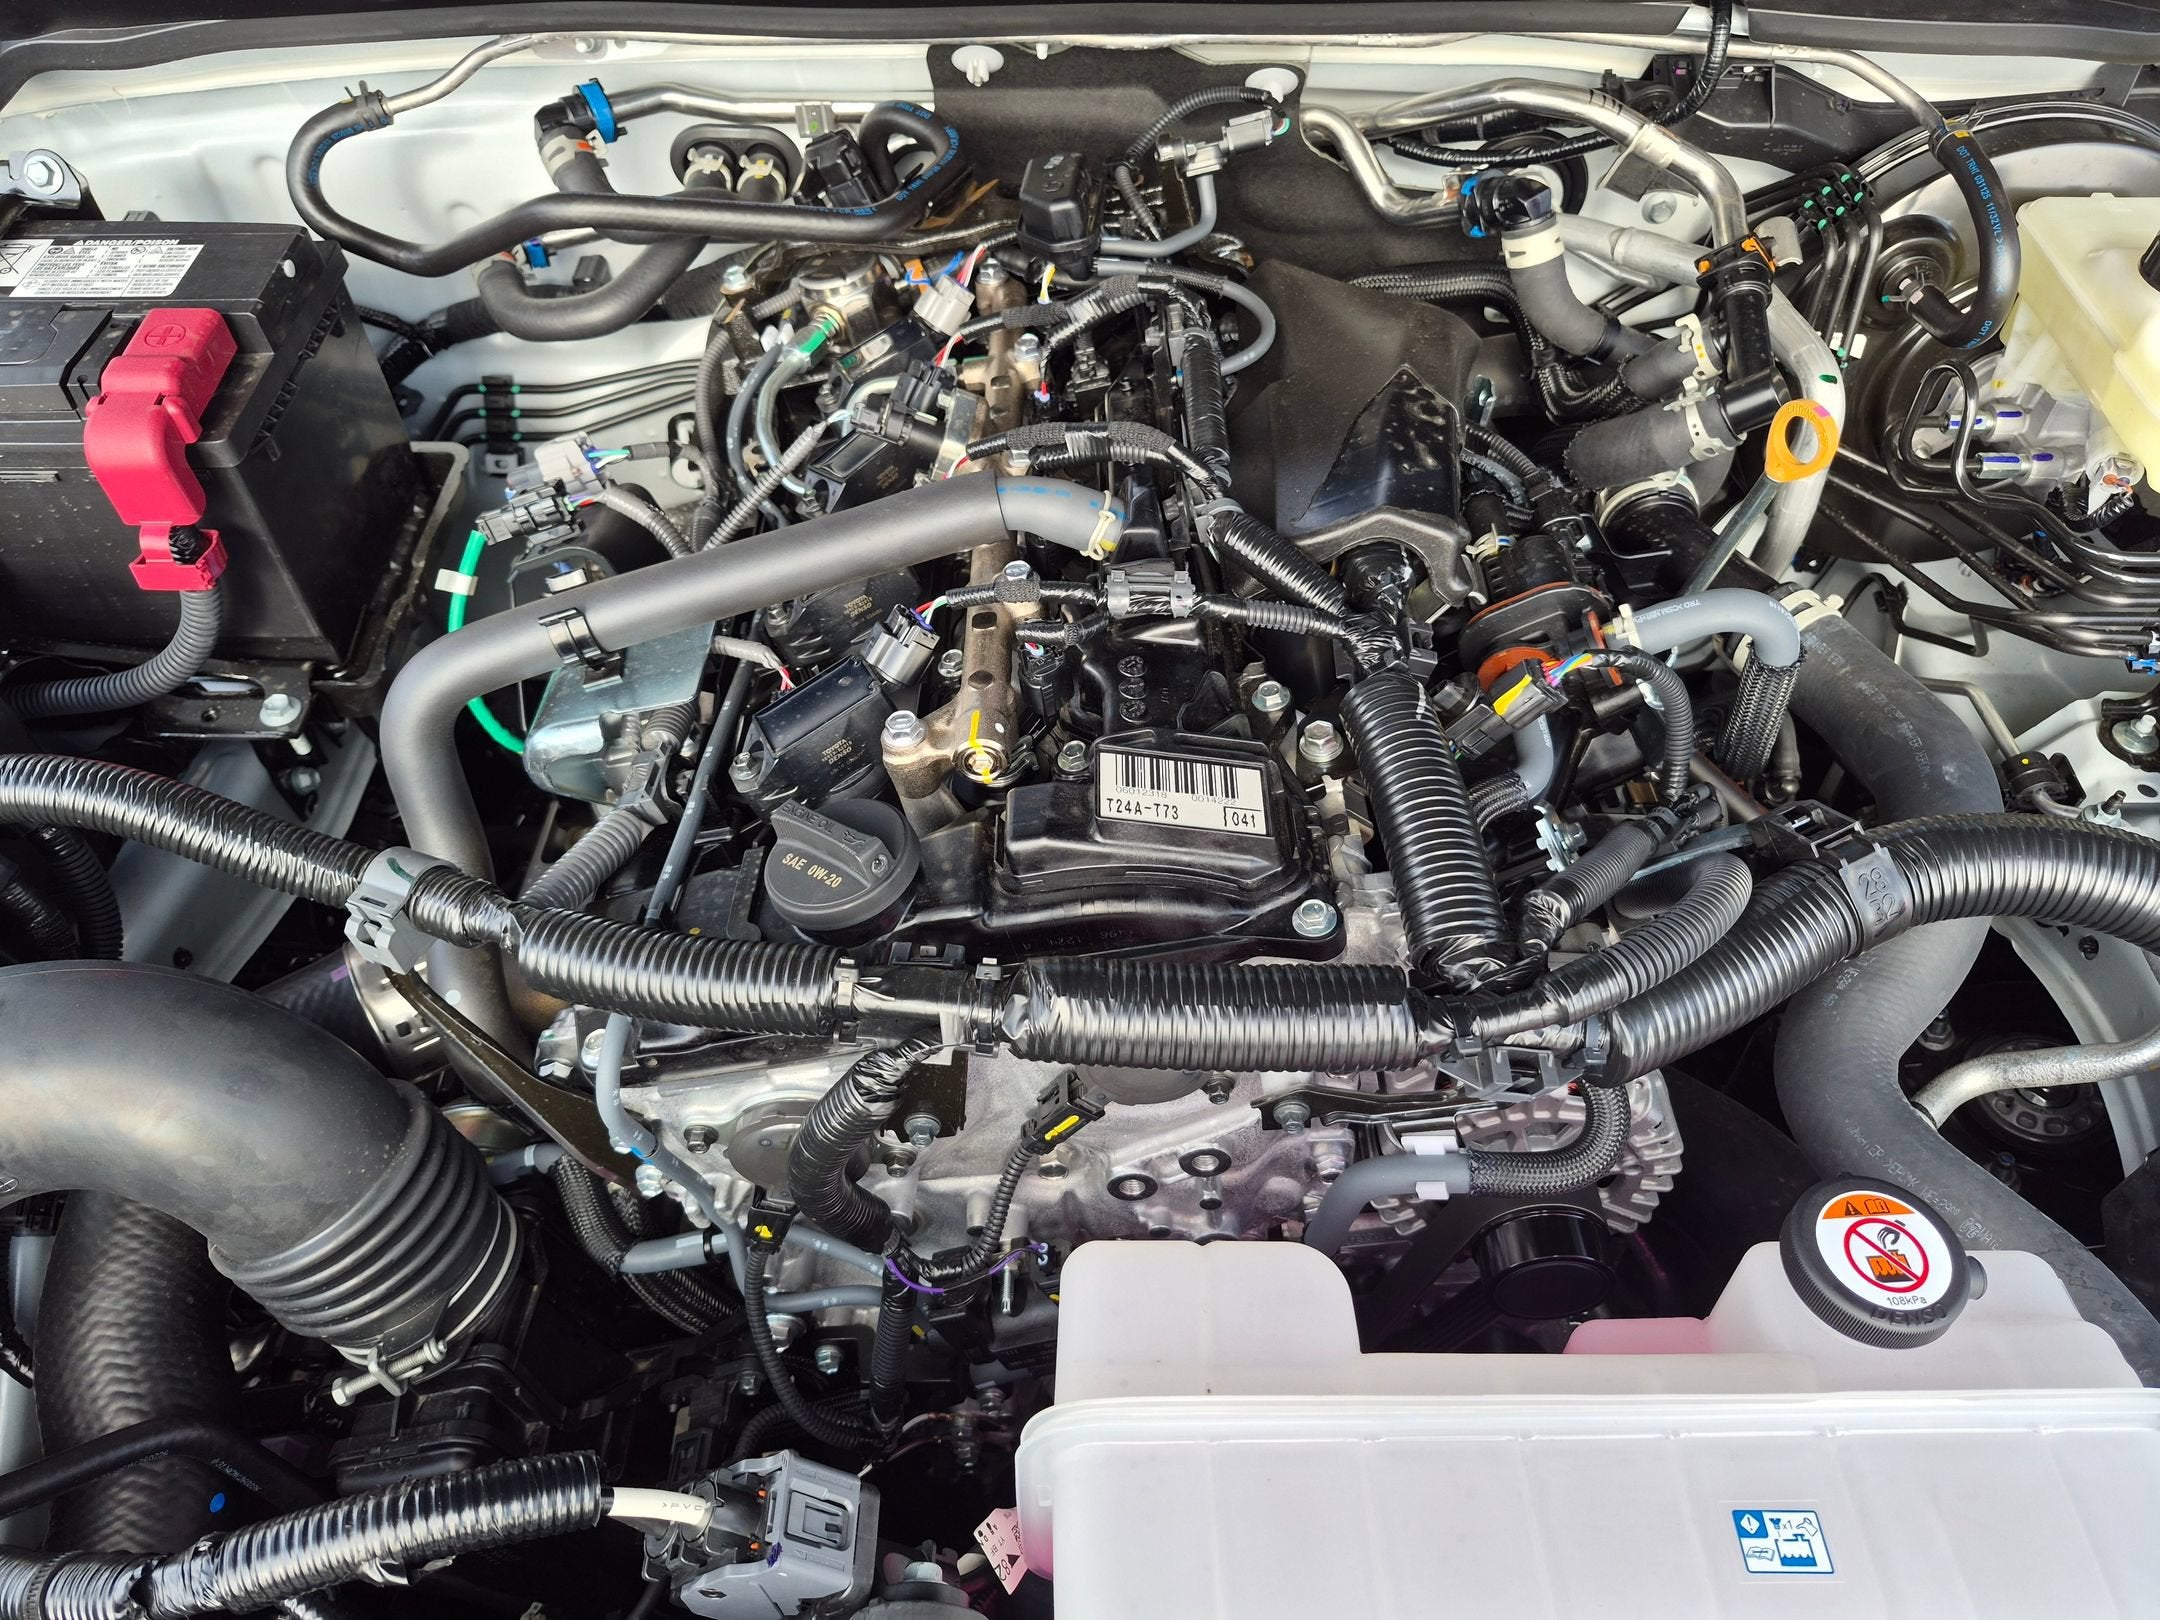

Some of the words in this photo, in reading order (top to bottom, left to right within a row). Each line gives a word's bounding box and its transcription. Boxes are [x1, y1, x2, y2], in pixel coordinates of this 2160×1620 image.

[1955, 145, 1970, 161] DOT
[1973, 172, 1993, 201] 031125
[1978, 320, 1993, 337] DOT
[844, 594, 871, 609] TOYOTA
[821, 739, 848, 757] TOYOTA
[828, 746, 852, 765] DENSO
[1115, 786, 1168, 800] 06012318
[1191, 793, 1238, 806] 0014222
[781, 802, 820, 825] ENGINE
[817, 820, 836, 835] OIL
[1106, 798, 1180, 820] T24A-T73
[1231, 811, 1256, 828] 041
[782, 853, 808, 871] SAE
[807, 864, 843, 888] 0W-20
[1886, 1295, 1928, 1306] 108kPa
[1871, 1303, 1947, 1328] DENSO
[1782, 1519, 1793, 1530] x1
[993, 1558, 1011, 1582] 82
